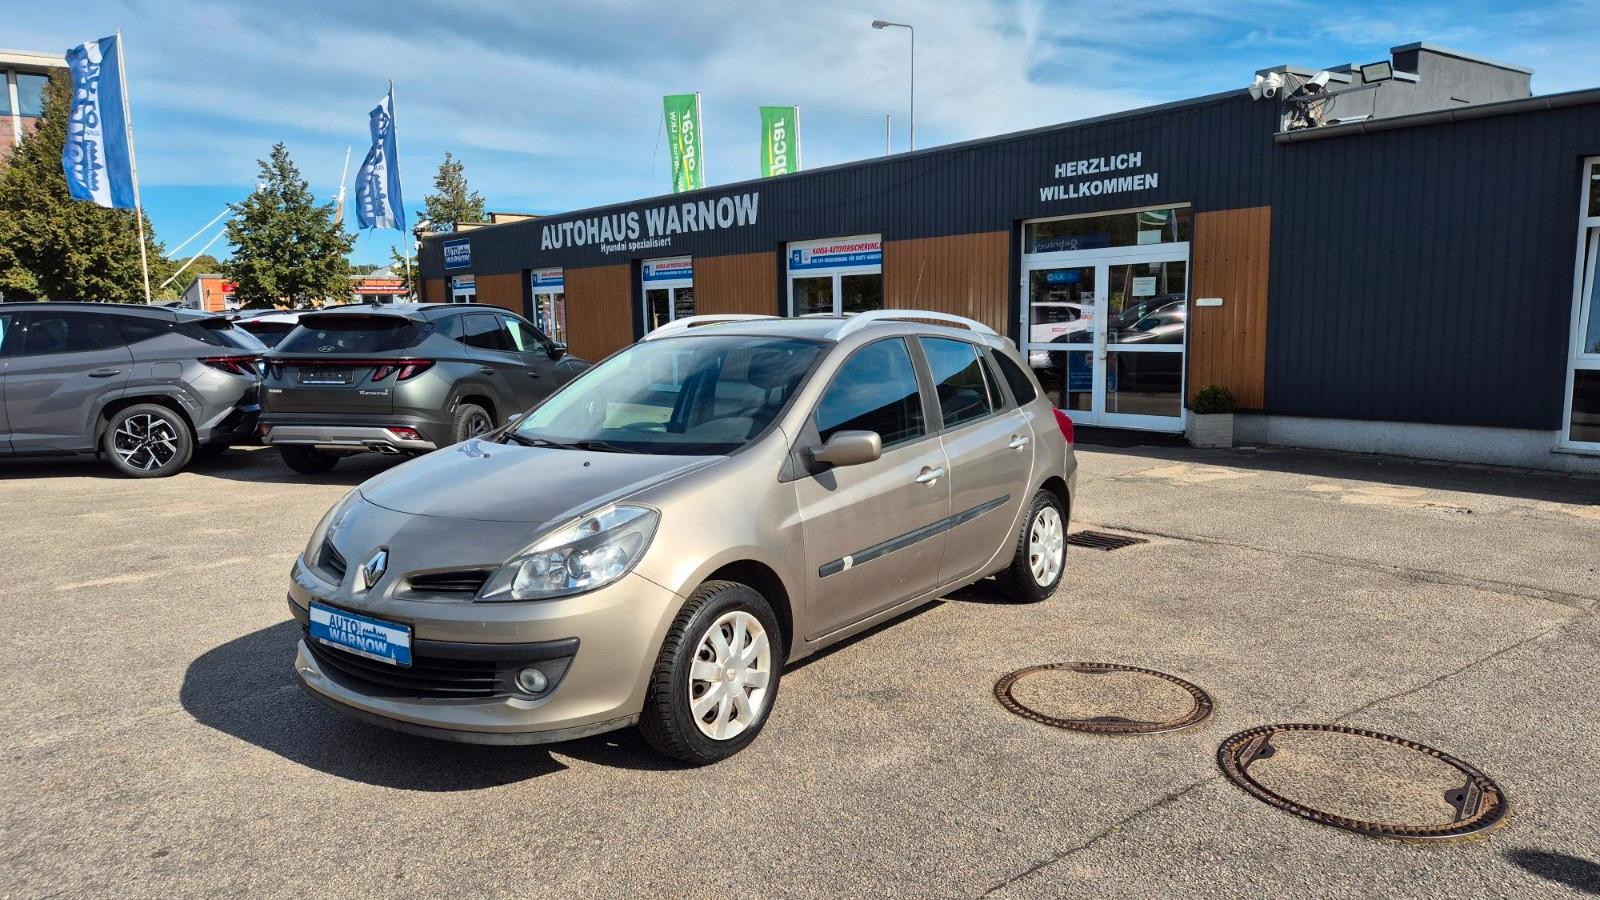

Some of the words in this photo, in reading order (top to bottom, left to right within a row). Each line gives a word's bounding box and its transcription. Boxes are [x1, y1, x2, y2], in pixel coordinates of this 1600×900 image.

[1054, 152, 1142, 178] HERZLICH
[1040, 173, 1159, 201] WILLKOMMEN
[541, 211, 640, 250] AUTOHAUS
[645, 192, 759, 237] WARNOW
[600, 242, 627, 255] Hyundai
[628, 236, 671, 252] spezialisiert
[329, 614, 358, 634] AUTO
[329, 627, 388, 653] WARNOW
